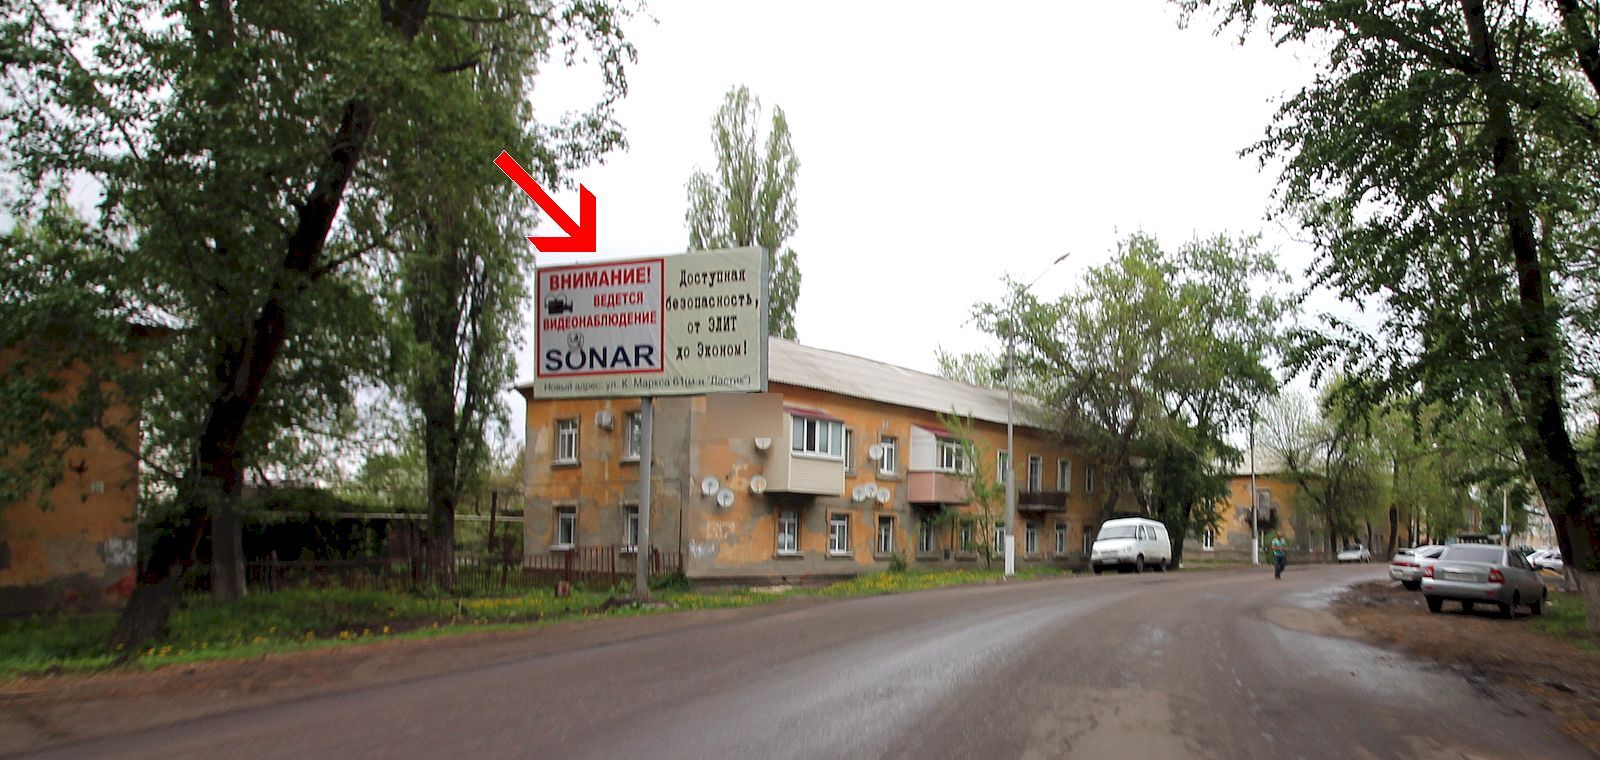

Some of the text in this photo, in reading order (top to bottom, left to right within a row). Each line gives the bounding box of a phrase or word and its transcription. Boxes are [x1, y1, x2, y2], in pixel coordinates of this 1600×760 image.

[549, 266, 651, 291] ВНИМАНИЕ!
[679, 269, 746, 288] Доступная
[593, 292, 644, 309] ВЕДЕТСЯ
[666, 293, 759, 312] безопасность,
[543, 310, 657, 332] ВИДЕОНАБЛЮДЕНИЕ
[687, 315, 737, 334] от ЭЛИТ
[545, 344, 655, 371] SONAR
[676, 341, 747, 361] до Эконом!
[544, 381, 573, 392] Новый
[633, 377, 670, 390] Маркса
